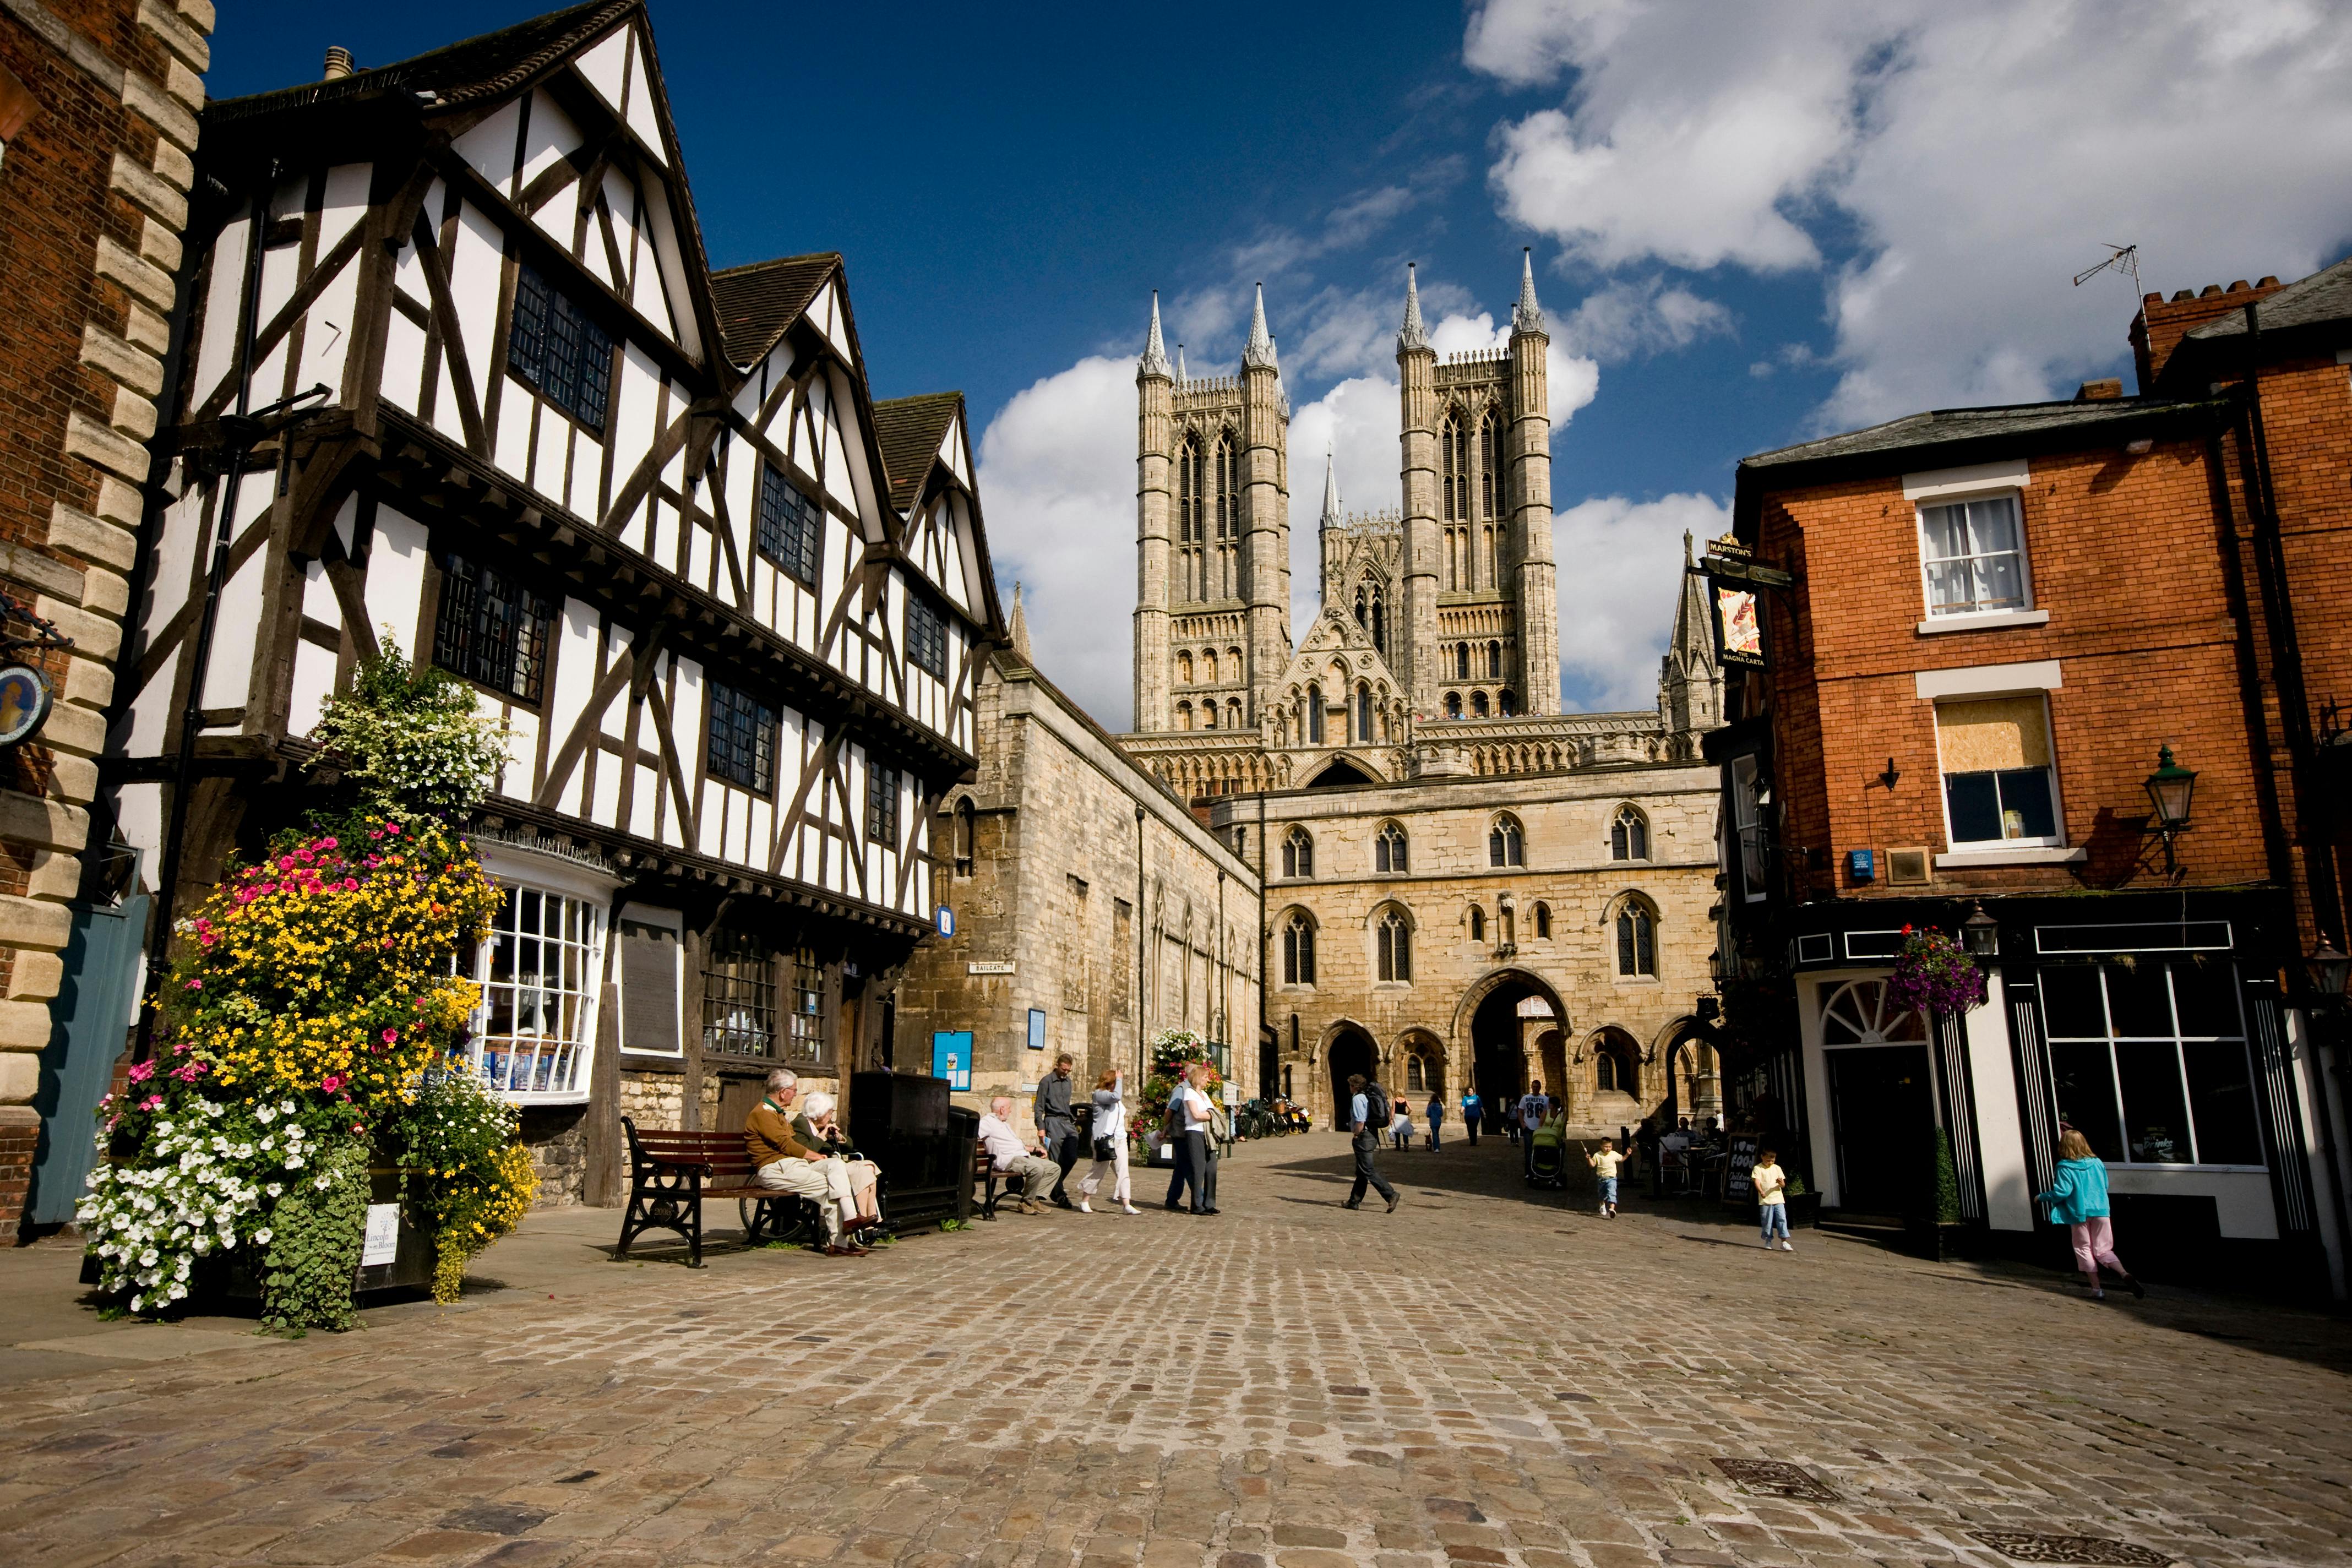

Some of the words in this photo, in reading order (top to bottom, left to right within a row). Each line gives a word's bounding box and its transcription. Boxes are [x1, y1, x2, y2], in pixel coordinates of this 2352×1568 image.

[1710, 543, 1751, 557] MARSTON'S
[1723, 654, 1745, 663] MAGNA
[1526, 1102, 1544, 1118] 86
[2144, 1138, 2174, 1149] Drinks
[1730, 1181, 1749, 1190] MENU
